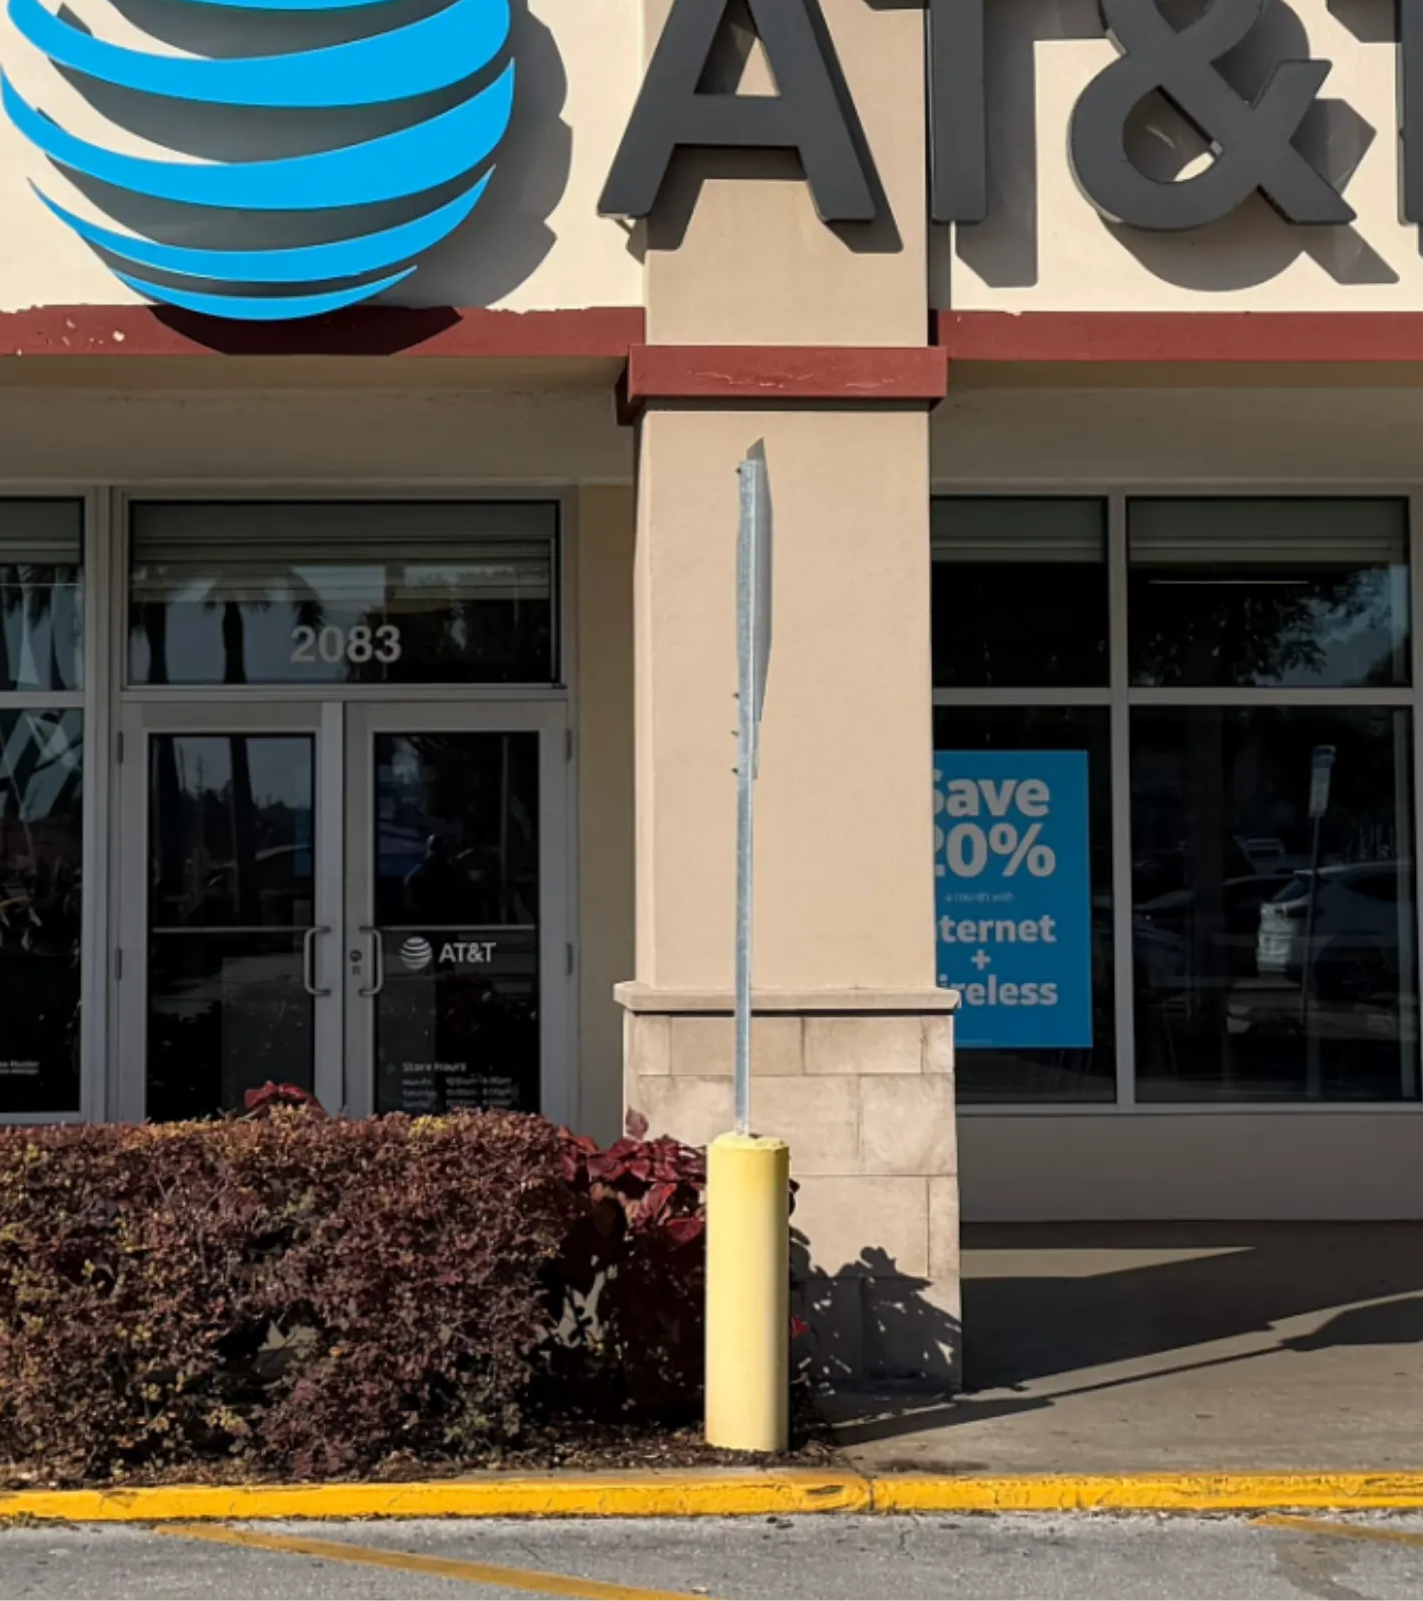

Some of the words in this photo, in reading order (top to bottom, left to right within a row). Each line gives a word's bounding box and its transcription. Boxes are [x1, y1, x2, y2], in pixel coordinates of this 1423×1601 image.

[290, 625, 402, 663] 2083
[938, 914, 1057, 943] ternet
[438, 942, 497, 964] AT&T
[938, 973, 1059, 1006] eless
